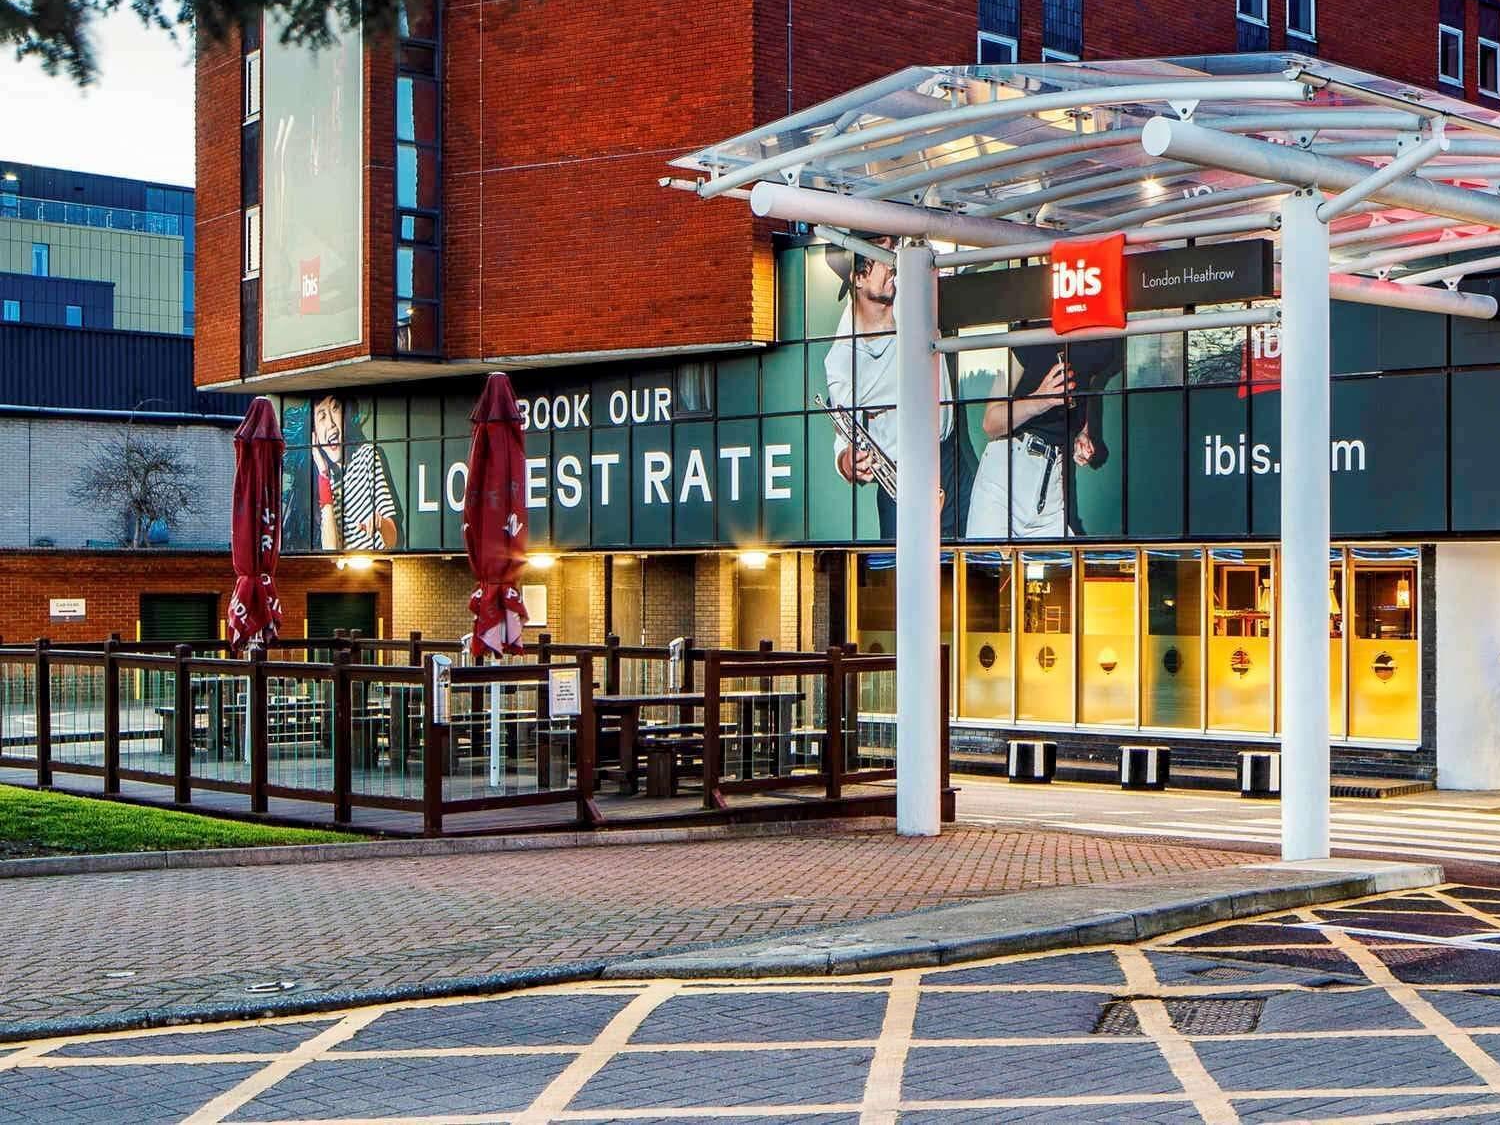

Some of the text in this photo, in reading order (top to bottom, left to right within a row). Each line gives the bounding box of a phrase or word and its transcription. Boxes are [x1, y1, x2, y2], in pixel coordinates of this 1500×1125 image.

[302, 274, 318, 298] ibis
[1053, 259, 1102, 299] ibis
[1142, 265, 1235, 288] London Heathrow
[515, 387, 672, 430] BOOK OUR
[1205, 434, 1366, 475] ibis.m
[418, 454, 619, 512] LOEST
[644, 444, 792, 504] RATE
